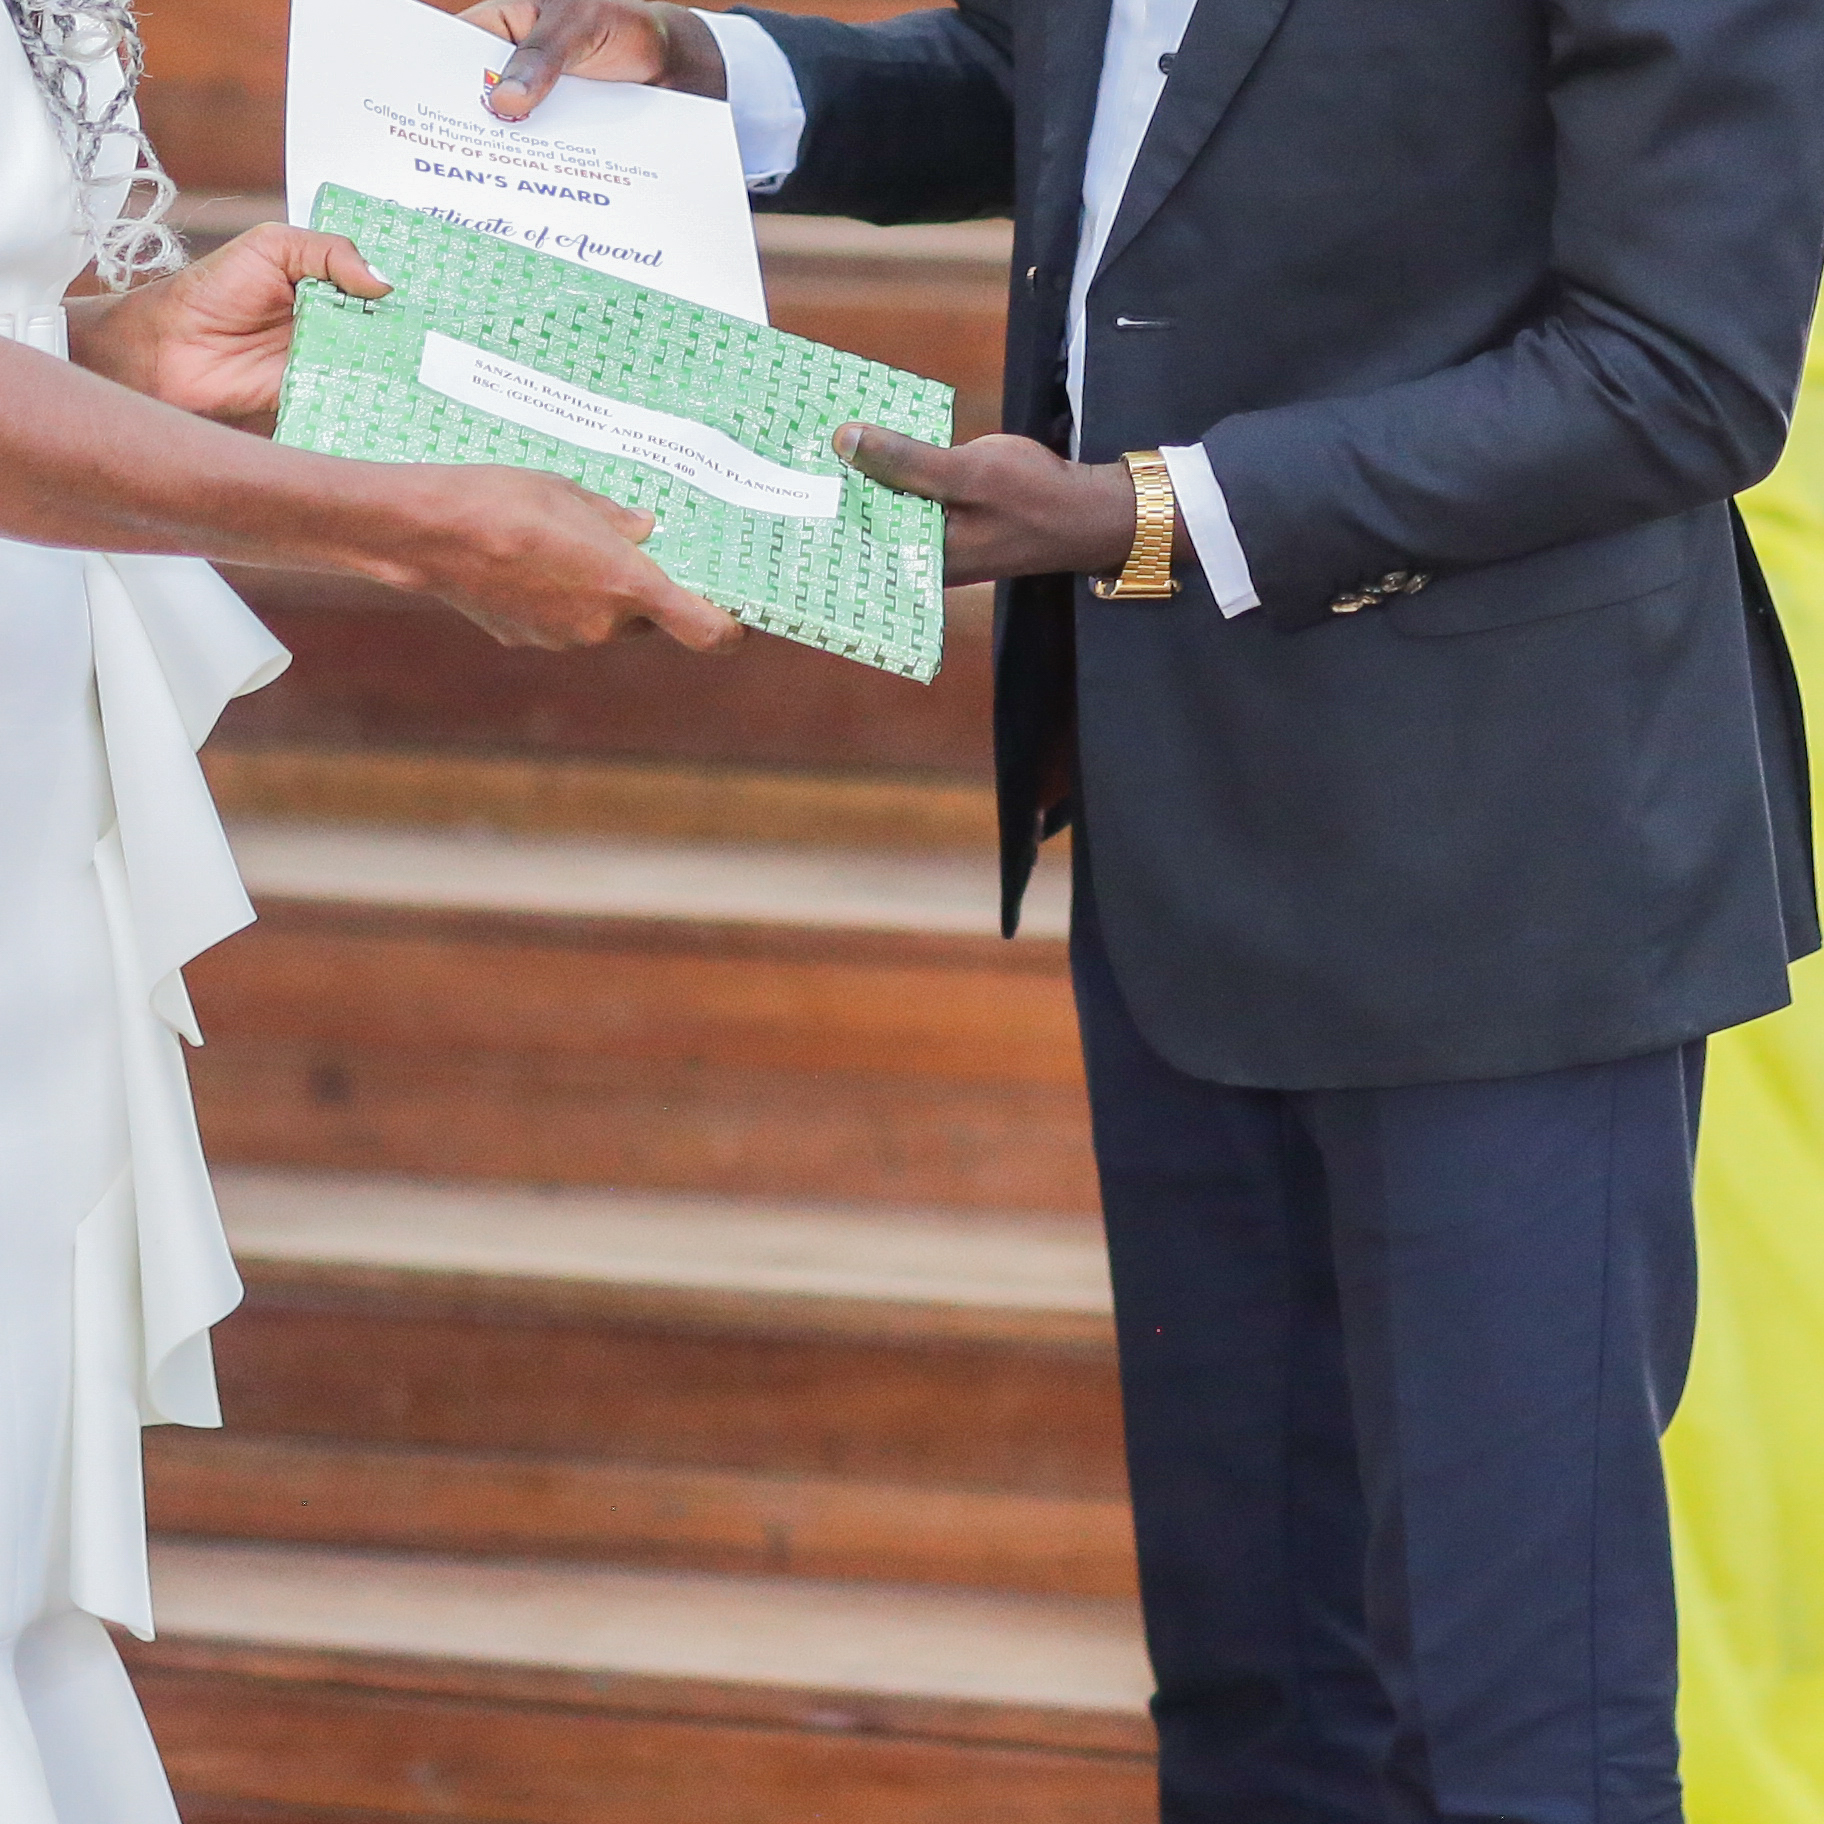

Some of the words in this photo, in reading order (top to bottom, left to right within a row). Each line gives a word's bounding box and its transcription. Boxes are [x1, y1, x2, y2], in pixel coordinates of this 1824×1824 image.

[363, 98, 416, 127] College
[420, 122, 433, 131] of
[439, 125, 522, 154] Humanities
[527, 148, 555, 160] and
[560, 153, 600, 168] Legal
[605, 160, 659, 179] Studies
[417, 102, 486, 135] University
[490, 129, 505, 138] of
[509, 131, 549, 147] Cape
[554, 140, 597, 155] Coast
[389, 125, 456, 153] FACULTY
[461, 147, 483, 158] OF
[489, 153, 549, 172] SOCIAL
[554, 164, 632, 186] SCIENCES
[414, 157, 508, 188] DEAN'S
[517, 179, 611, 206] AWARD
[524, 226, 550, 249] of
[555, 233, 664, 268] Award
[542, 384, 614, 417] RAPHAEL
[507, 388, 608, 430] (GEOGRAPHY
[610, 426, 644, 440] AND
[647, 435, 725, 475] REGIONAL
[726, 469, 810, 500] PLANNING)
[621, 443, 671, 467] LEVEL
[674, 462, 696, 477] 400
